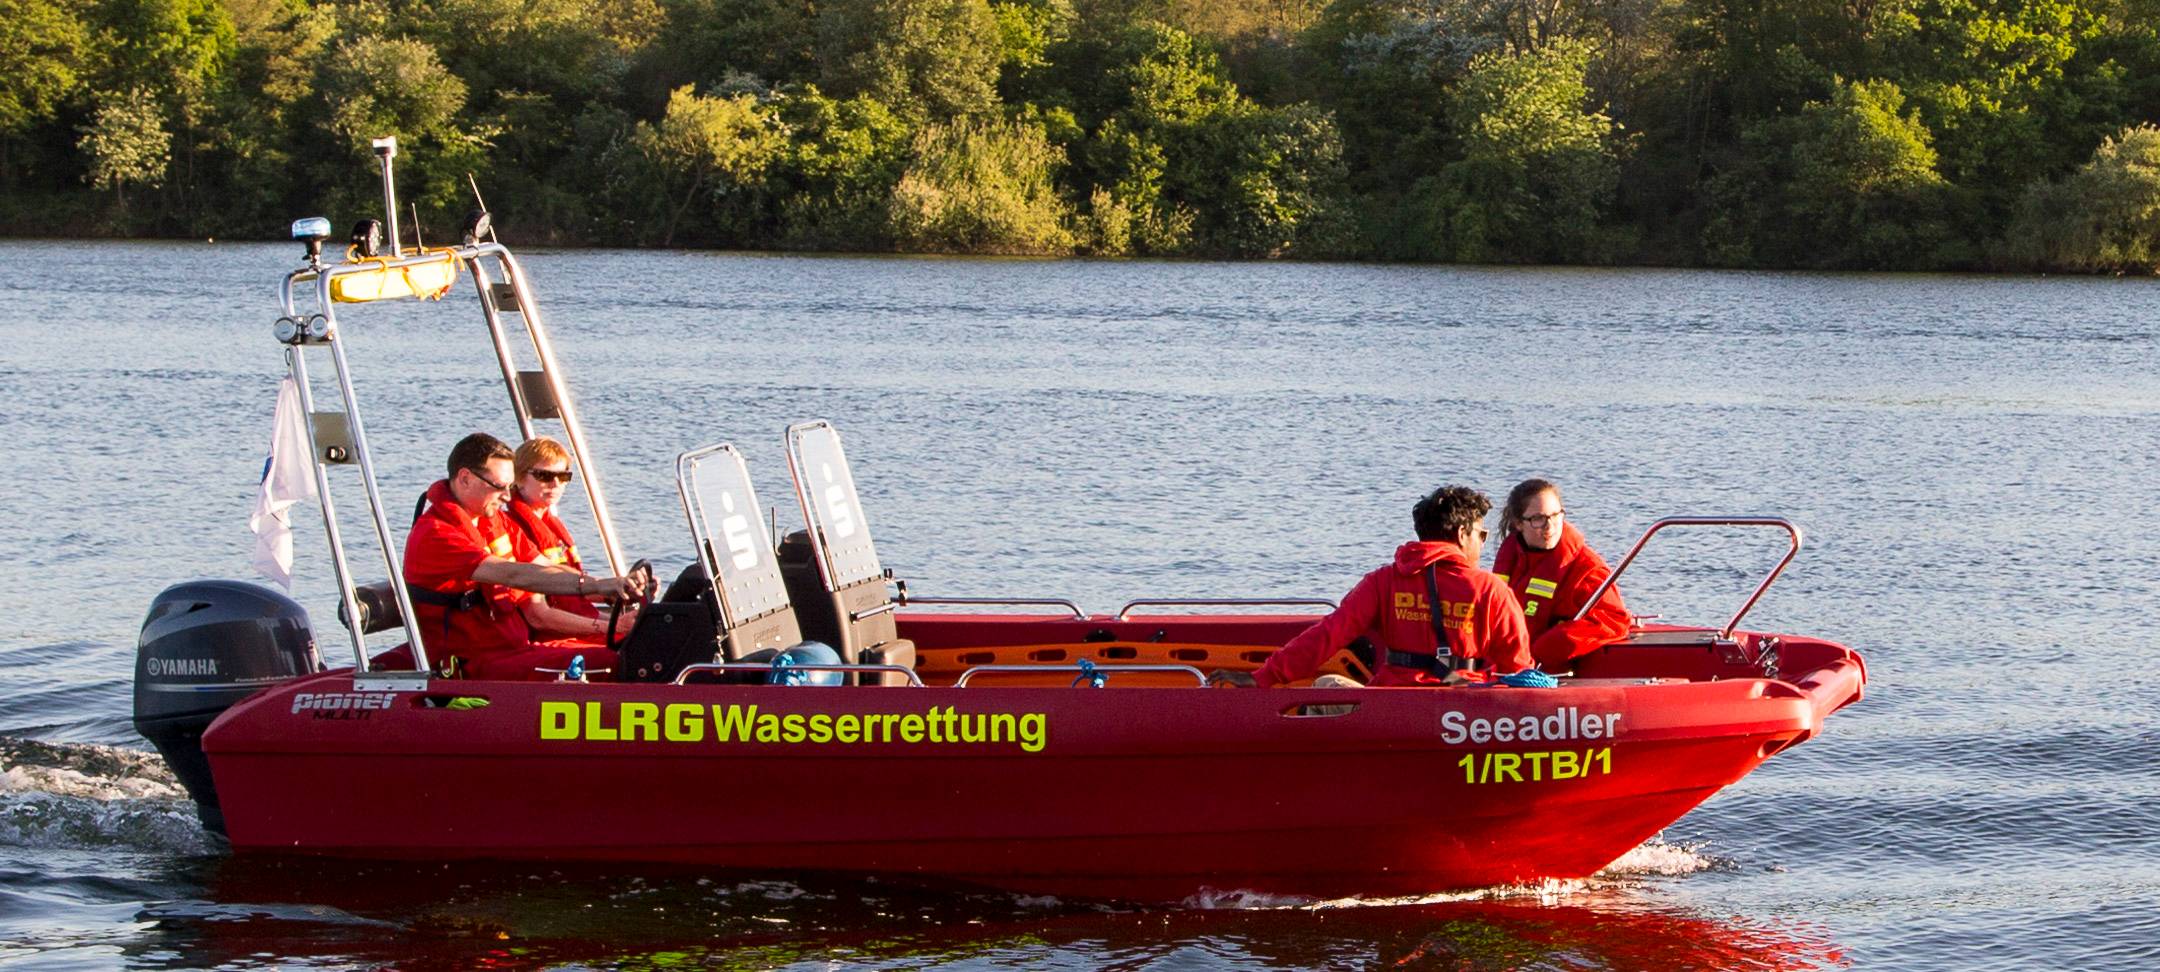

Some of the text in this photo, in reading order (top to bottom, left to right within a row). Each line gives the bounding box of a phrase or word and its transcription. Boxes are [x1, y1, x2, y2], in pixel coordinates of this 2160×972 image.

[160, 658, 217, 675] YAMAHA
[291, 693, 397, 714] pioner
[540, 702, 1047, 752] DLRG Wasserrettung
[1441, 707, 1622, 744] Seeadler
[1458, 748, 1611, 784] 1/RTB/1
